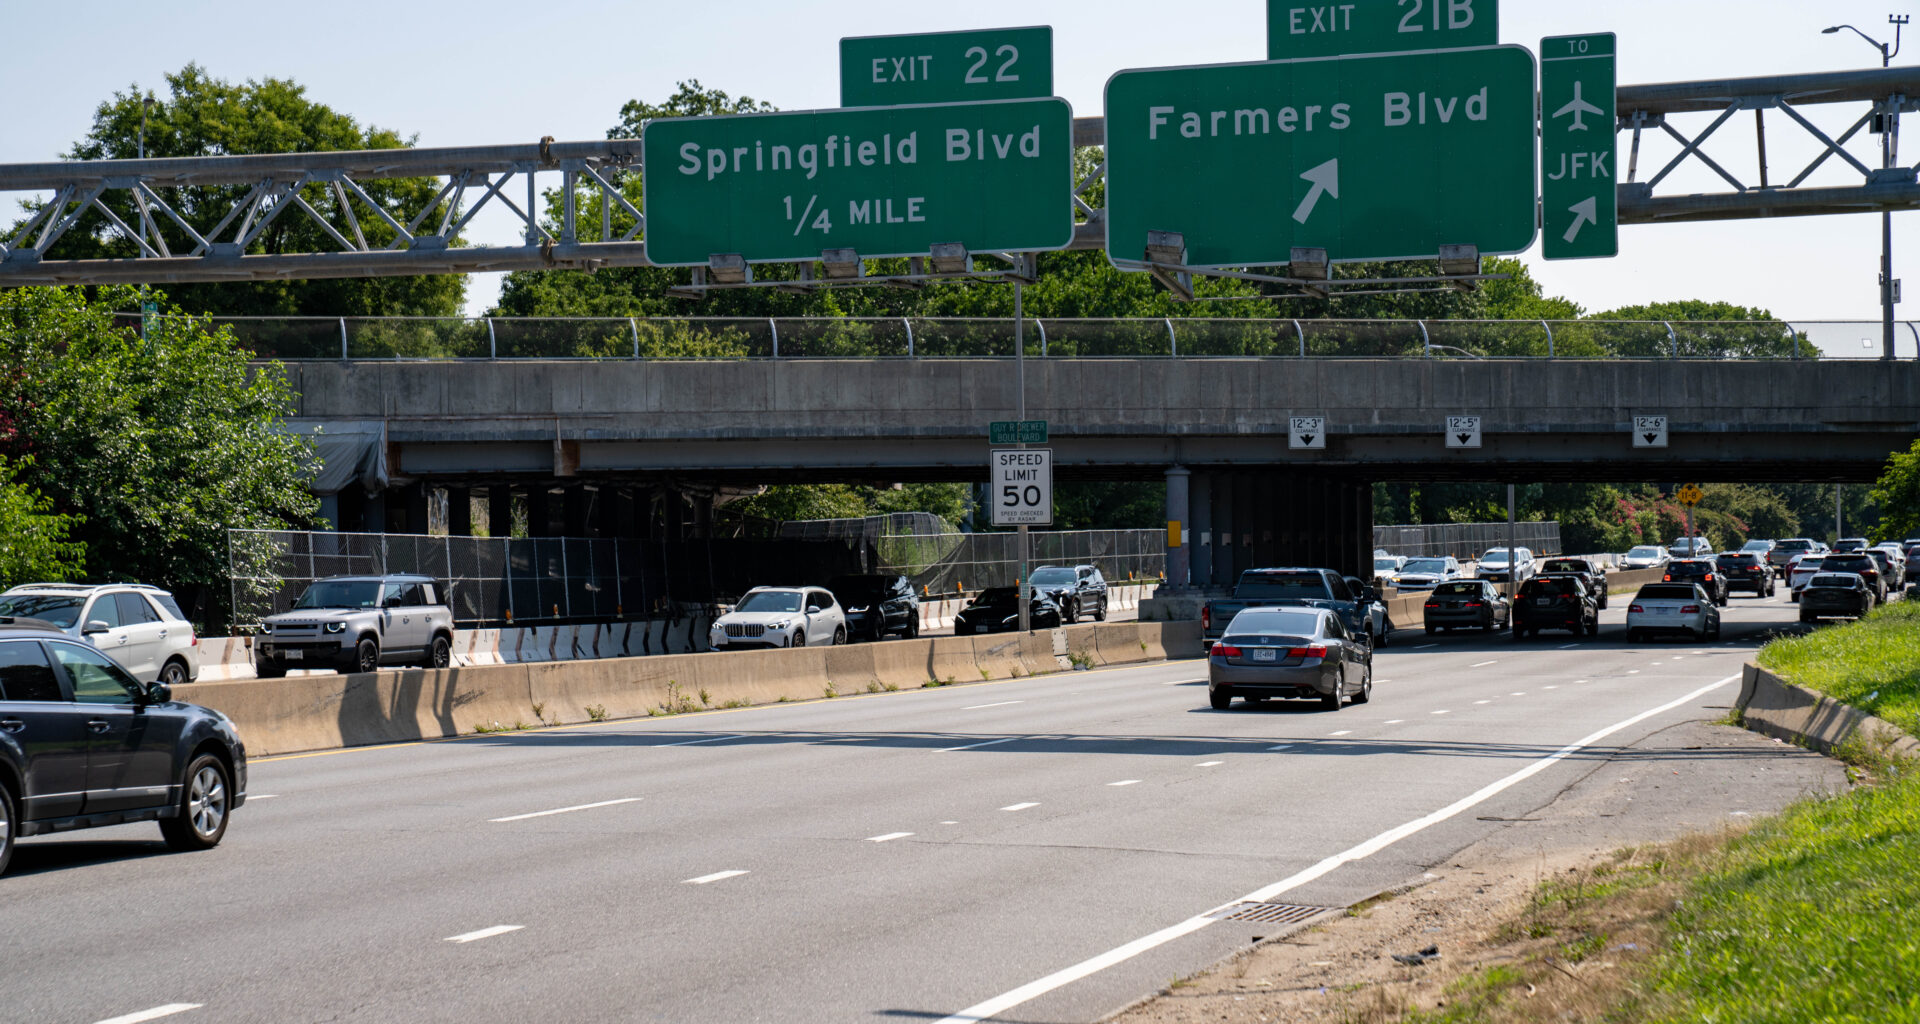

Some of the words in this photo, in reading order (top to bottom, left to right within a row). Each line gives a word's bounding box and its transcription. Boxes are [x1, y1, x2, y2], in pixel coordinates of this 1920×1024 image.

[1289, 5, 1355, 34] EXIT
[1397, 0, 1474, 33] 21B
[1567, 39, 1589, 54] TO
[872, 55, 933, 83] EXIT
[964, 44, 1019, 84] 22
[1149, 101, 1351, 140] Farmers
[1384, 86, 1487, 127] Blvd
[678, 131, 917, 181] Springfield
[946, 125, 1040, 162] Blvd
[1548, 151, 1609, 180] JFK
[849, 197, 926, 225] MILE
[1292, 418, 1322, 429] 12'-3"
[1449, 417, 1478, 428] 12'-5"
[997, 432, 1040, 442] BOULEVARD
[1000, 454, 1043, 466] SPEED
[1004, 469, 1038, 481] LIMIT
[1003, 485, 1041, 507] 50
